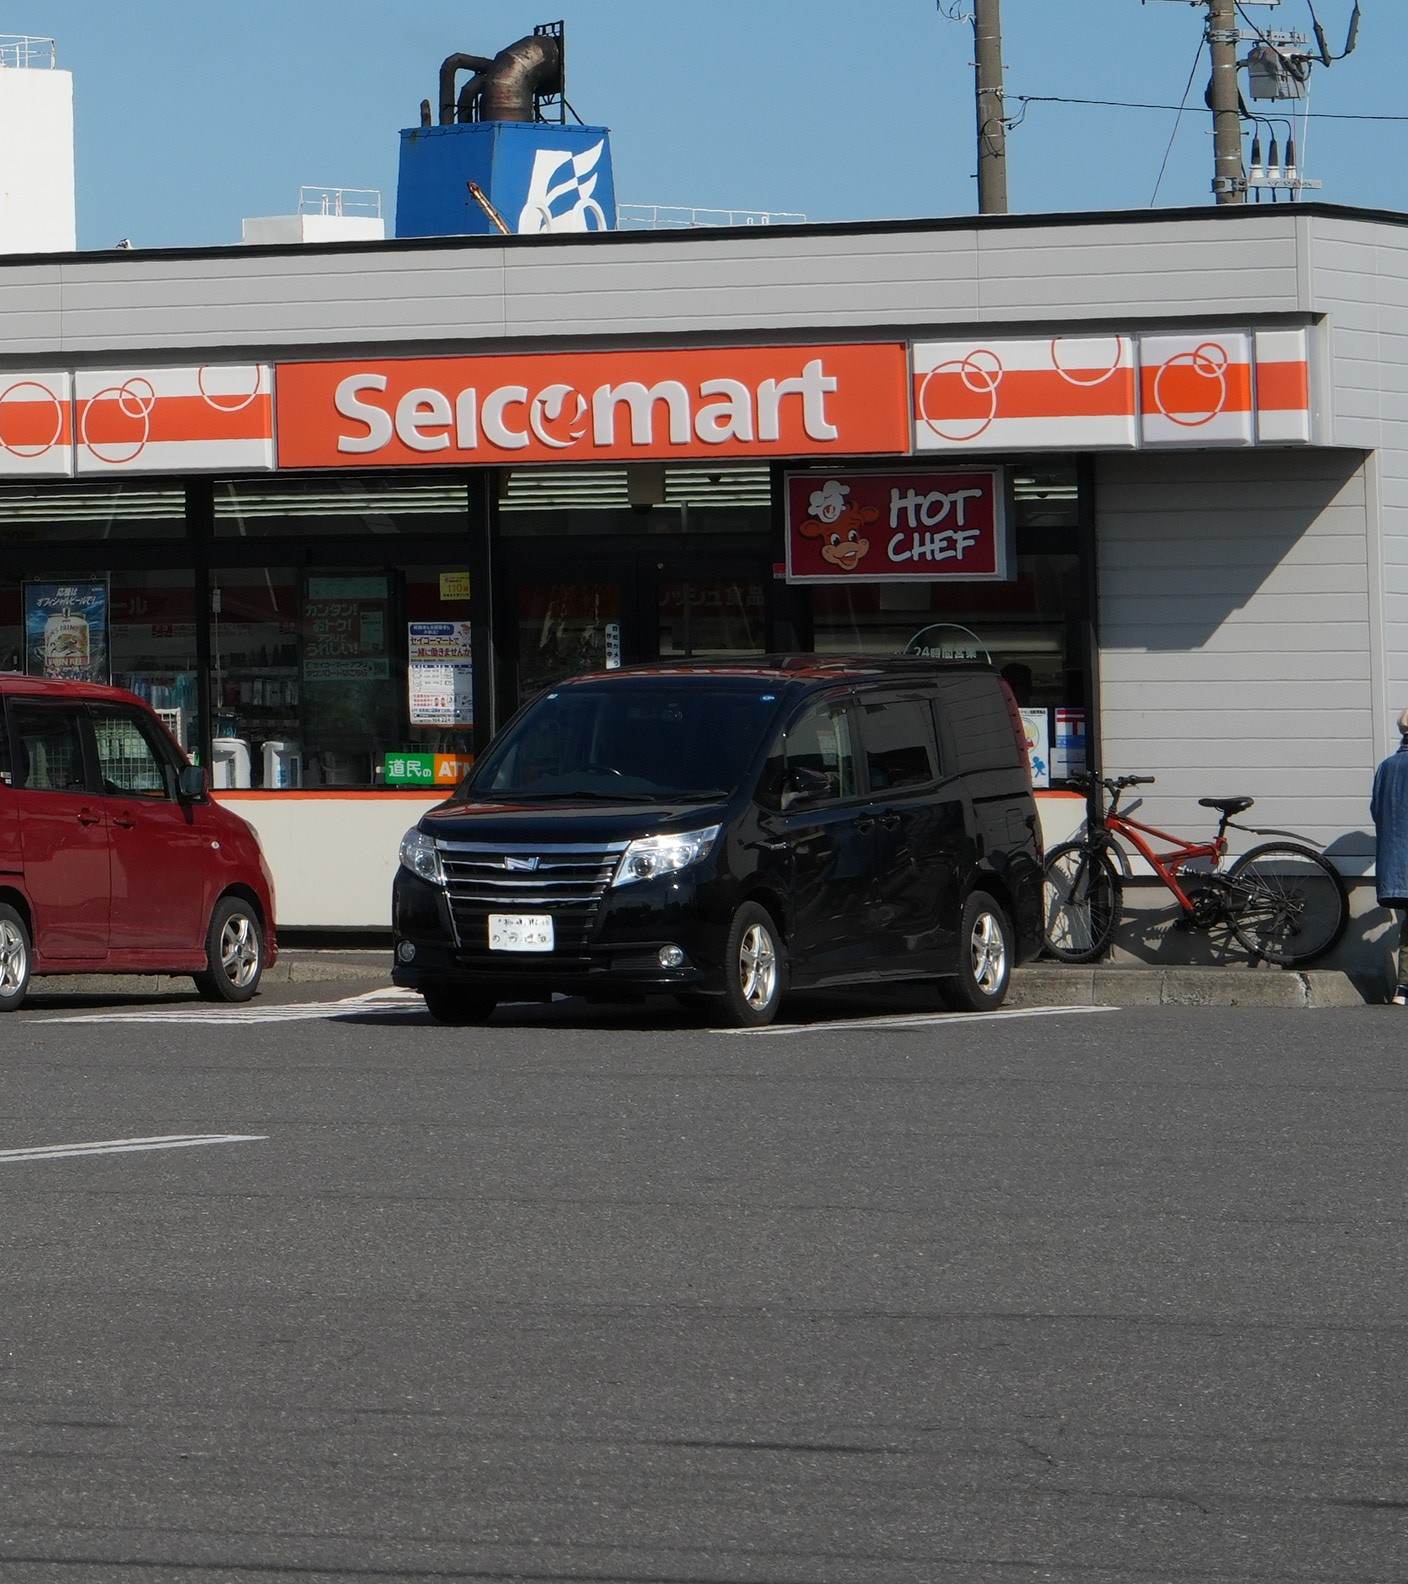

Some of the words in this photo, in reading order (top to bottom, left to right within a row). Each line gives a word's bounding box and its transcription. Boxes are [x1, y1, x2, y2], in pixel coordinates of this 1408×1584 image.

[334, 359, 839, 453] Seicomart
[889, 487, 983, 529] HOT
[887, 528, 981, 563] CHEF
[410, 636, 460, 646] セイコーマートで
[388, 759, 432, 778] 道民の
